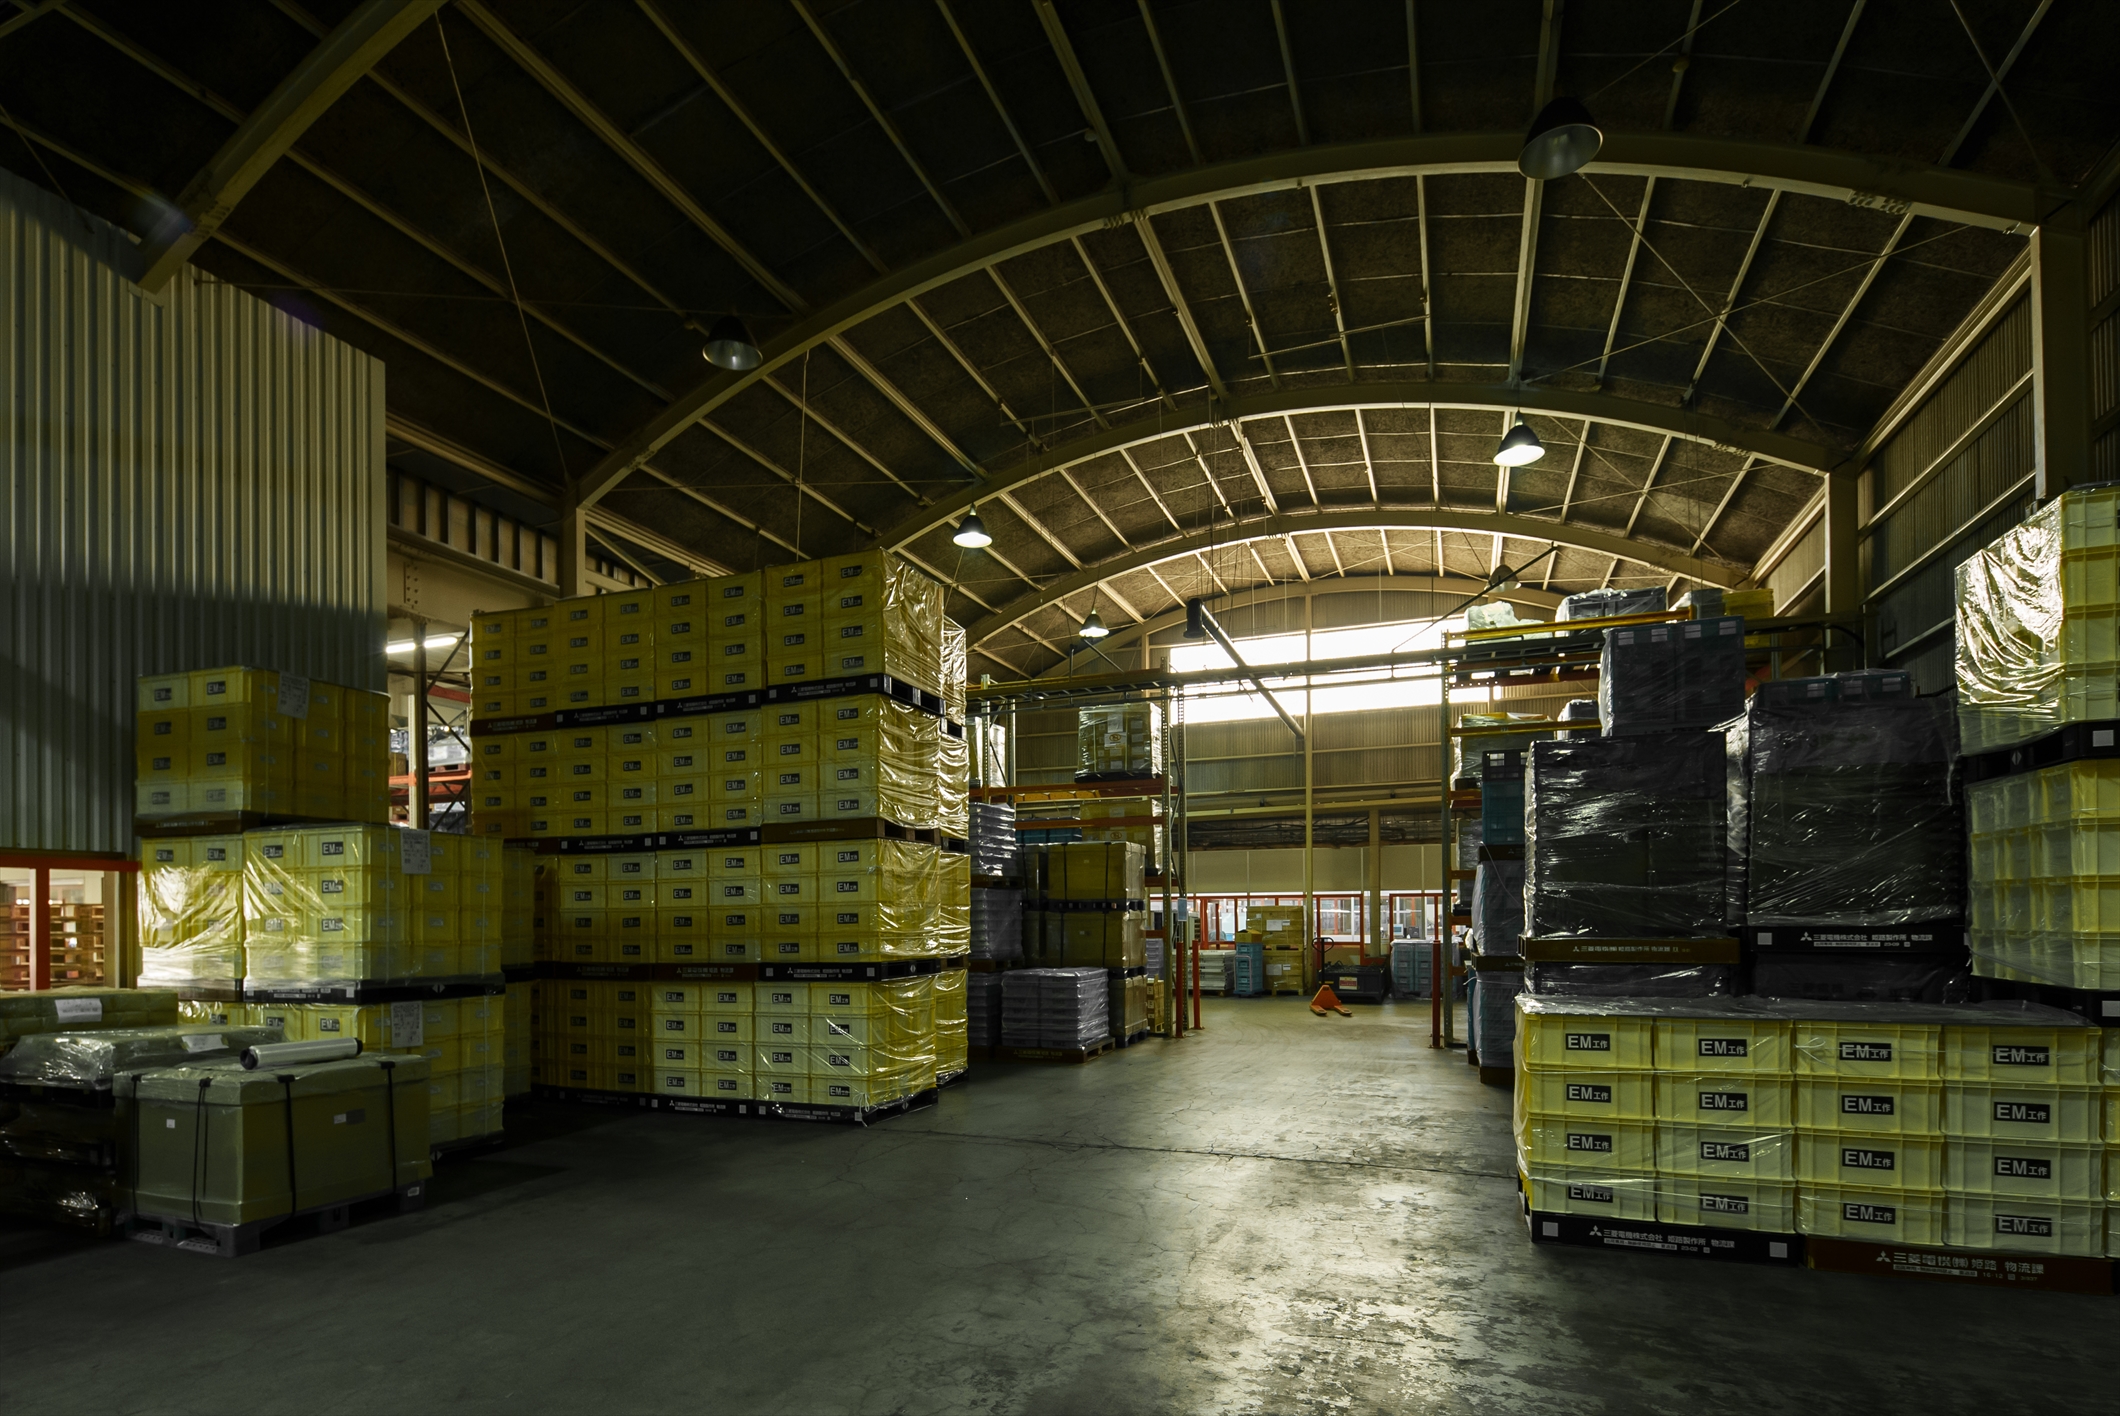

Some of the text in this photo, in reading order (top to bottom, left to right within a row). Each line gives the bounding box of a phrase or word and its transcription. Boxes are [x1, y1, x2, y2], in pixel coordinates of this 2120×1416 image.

[1567, 1035, 1609, 1050] EM工作
[1700, 1041, 1748, 1056] EM工作
[1840, 1044, 1890, 1061] EM工作
[1994, 1048, 2048, 1064] EM工作
[1568, 1086, 1610, 1101] EM工作
[1700, 1094, 1746, 1110] EM工作
[1843, 1097, 1892, 1113] EM工作
[1995, 1104, 2048, 1122] EM工作
[1566, 1135, 1610, 1151] EM工作
[1702, 1144, 1749, 1160] EM工作
[1844, 1151, 1892, 1168] EM工作
[1996, 1159, 2048, 1177] EM工作
[1569, 1186, 1612, 1201] EM工作
[1700, 1196, 1747, 1213] EM工作
[1845, 1205, 1893, 1222] EM工作
[1996, 1216, 2049, 1235] EM工作
